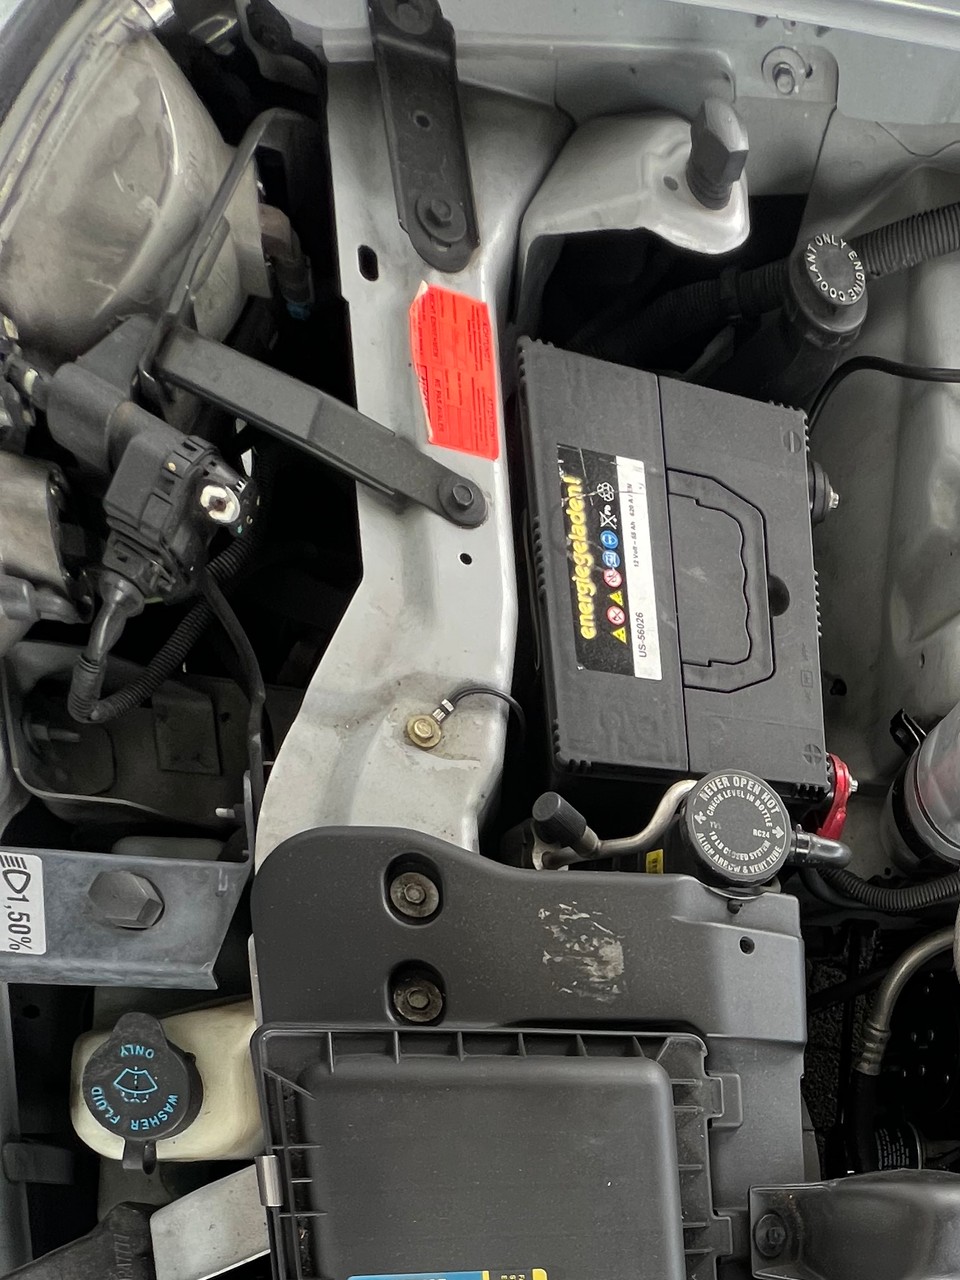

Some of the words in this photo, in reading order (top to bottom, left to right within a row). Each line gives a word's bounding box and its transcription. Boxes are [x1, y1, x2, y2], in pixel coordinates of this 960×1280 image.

[815, 233, 846, 248] ONLY
[806, 244, 845, 301] COOLANT
[848, 250, 864, 300] ENGINE
[561, 474, 596, 638] energiegeladen!
[635, 611, 647, 657] US-56026
[700, 776, 730, 801] NEVER
[733, 776, 761, 794] OPEN
[761, 793, 780, 813] HOT
[706, 794, 724, 816] CHECK
[724, 790, 745, 798] LEVEL
[746, 793, 754, 802] IN
[755, 799, 772, 826] BOTTLE
[697, 832, 715, 855] ALIGN
[749, 862, 768, 873] VENT
[768, 846, 782, 865] TUBE
[749, 840, 771, 860] SYSTEM
[4, 895, 32, 950] 1,50%
[120, 1044, 154, 1059] ONLY
[91, 1086, 120, 1124] FLUID
[130, 1094, 178, 1130] WASHER
